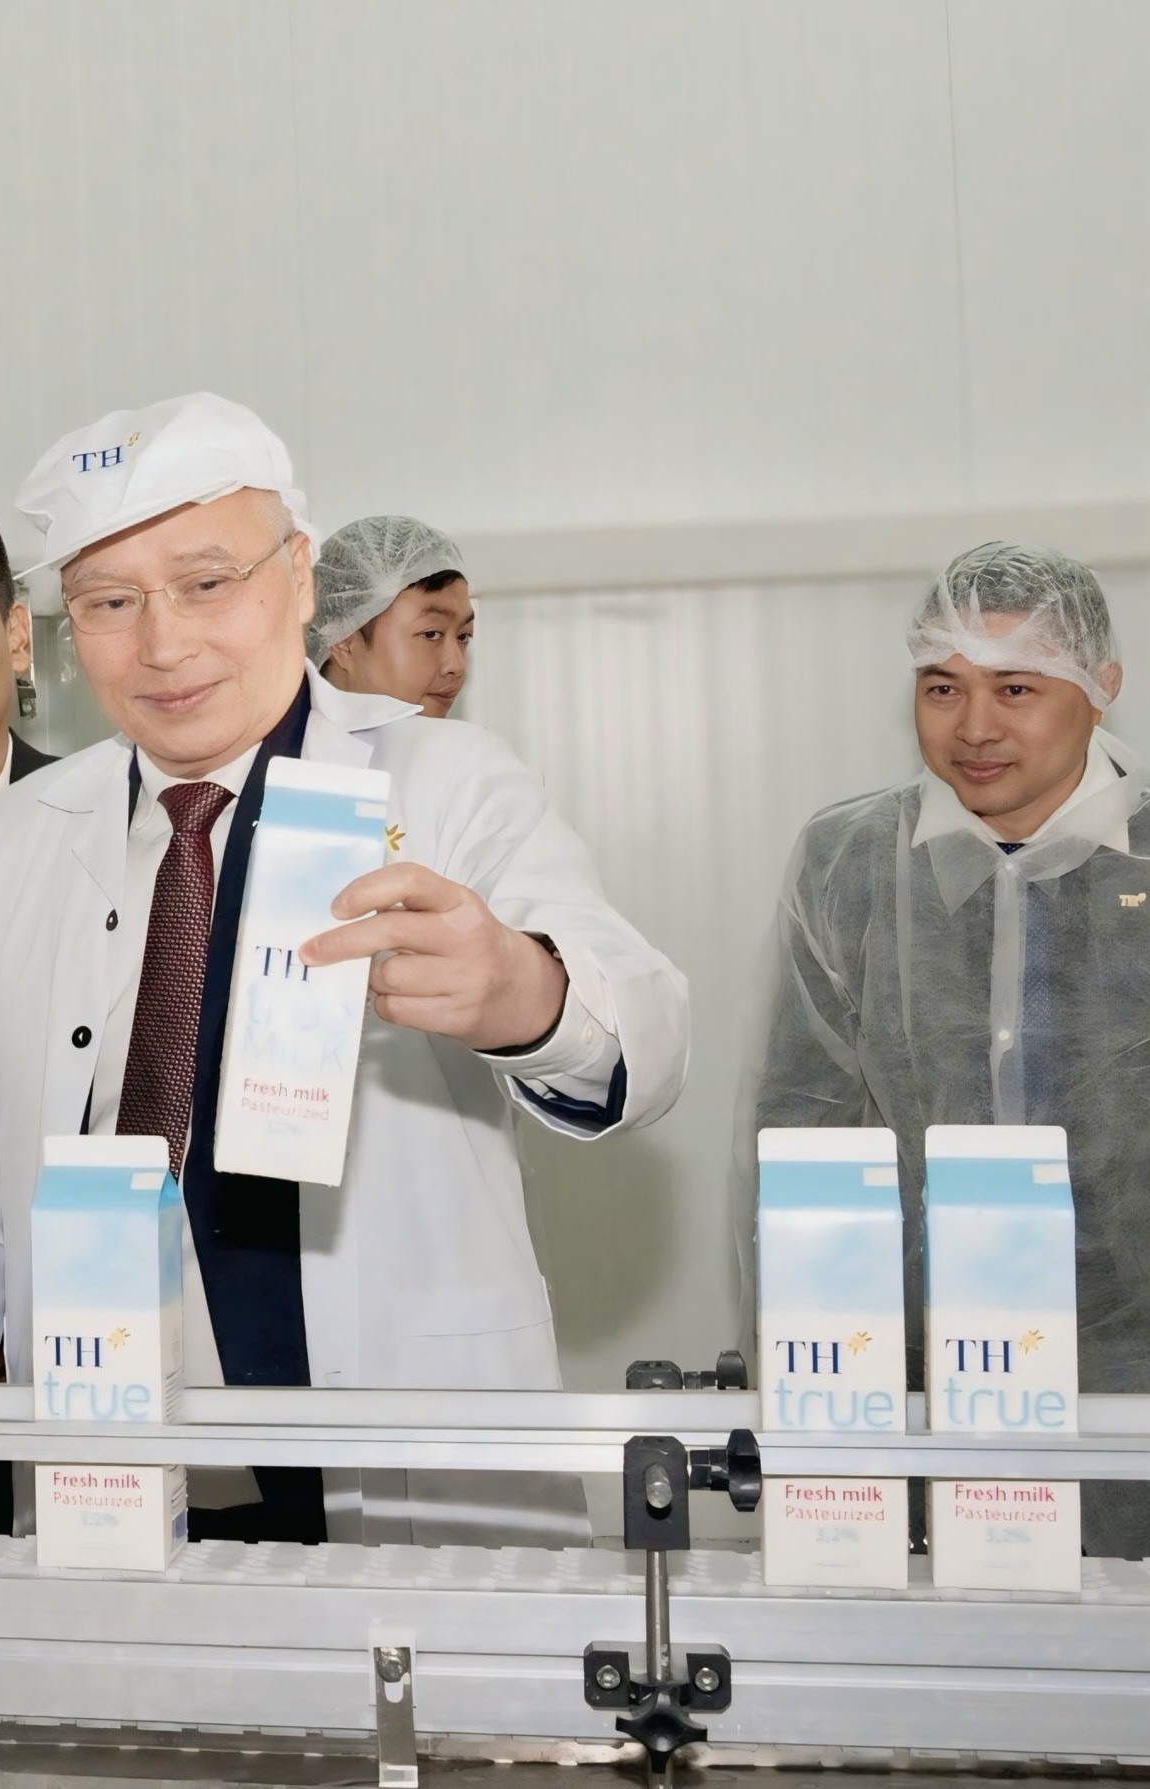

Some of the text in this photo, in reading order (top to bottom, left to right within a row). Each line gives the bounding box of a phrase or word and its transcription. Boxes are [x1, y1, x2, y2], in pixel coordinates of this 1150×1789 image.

[72, 445, 124, 473] TH
[243, 1078, 330, 1102] Fresh milk
[45, 1335, 103, 1368] TH
[776, 1341, 842, 1374] TH
[946, 1339, 1013, 1373] TH
[43, 1371, 150, 1419] true
[774, 1378, 893, 1427] true
[943, 1377, 1066, 1427] true
[53, 1472, 141, 1489] Fresh milk
[785, 1484, 882, 1501] Fresh milk
[955, 1484, 1055, 1502] Fresh milk
[54, 1492, 142, 1507] Pasteurized
[786, 1505, 884, 1521] Pasteurized
[955, 1505, 1057, 1522] Pasteurized
